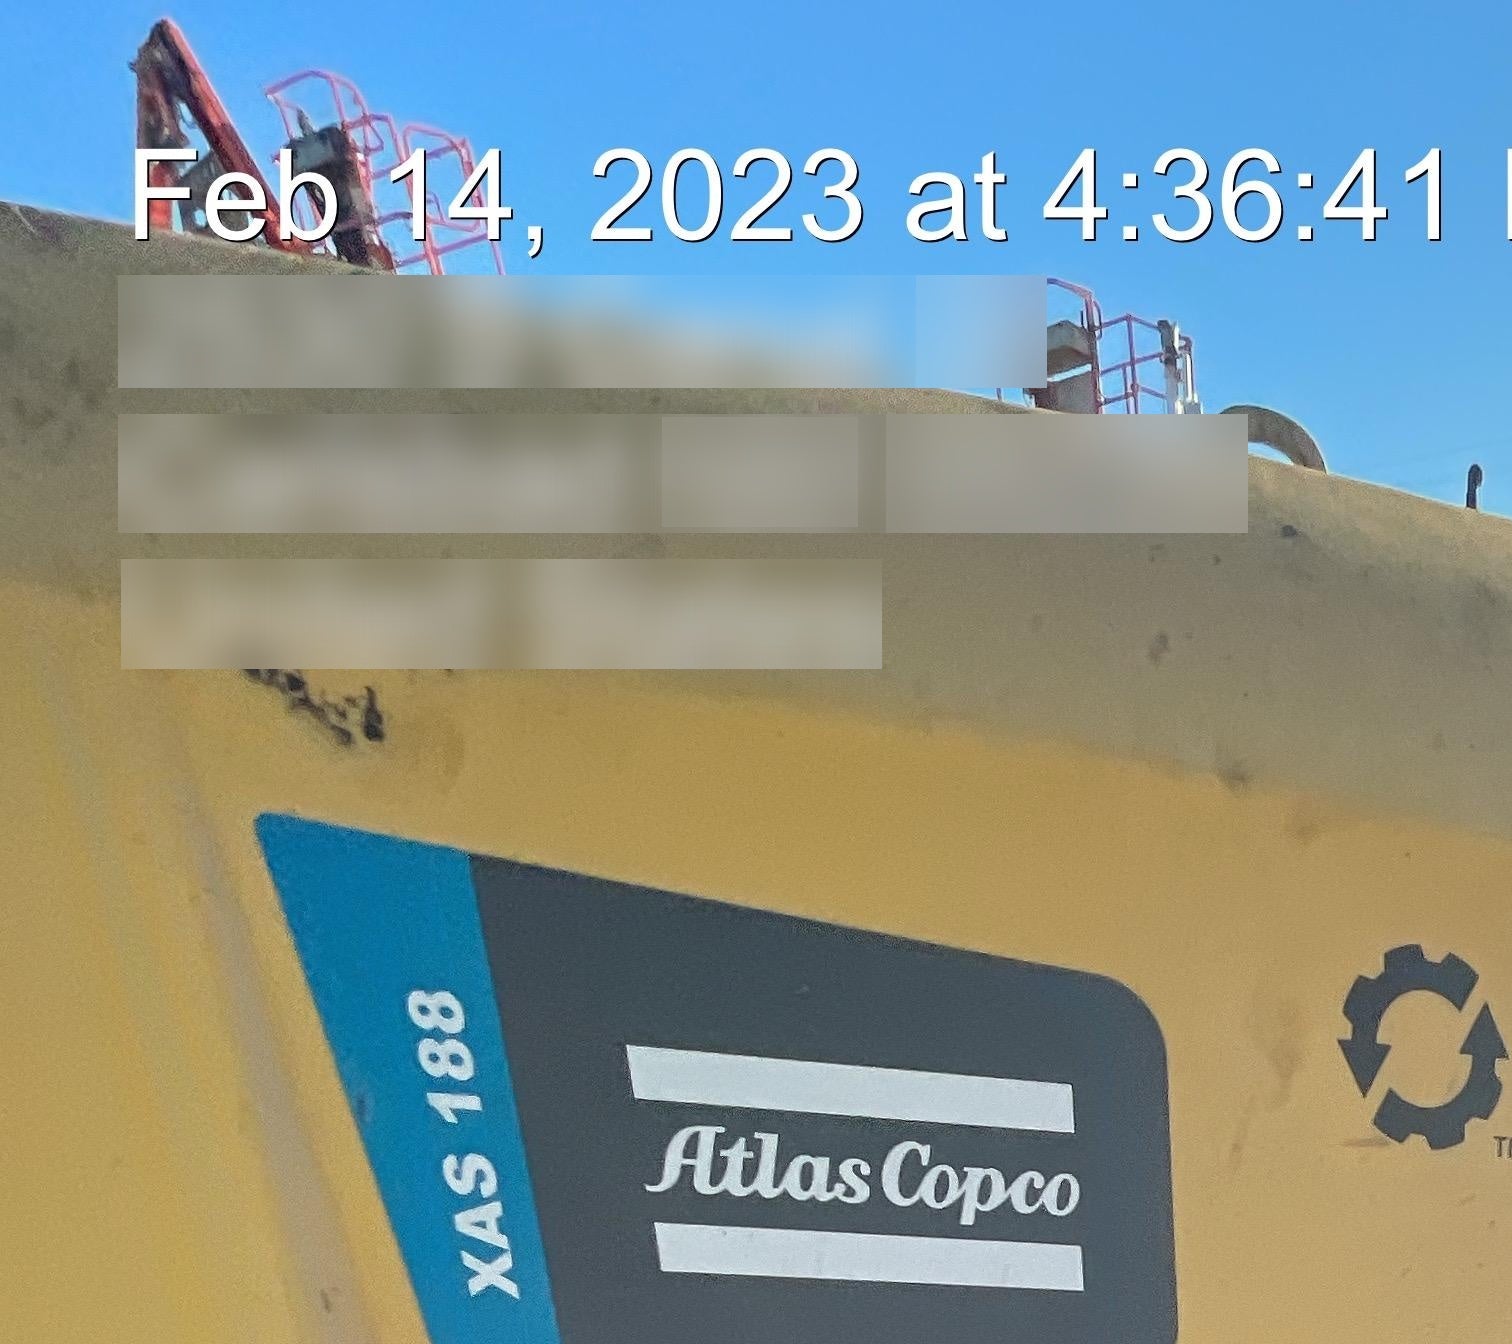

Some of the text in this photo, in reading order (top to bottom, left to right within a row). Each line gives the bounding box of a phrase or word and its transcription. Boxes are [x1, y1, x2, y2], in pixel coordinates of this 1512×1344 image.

[405, 988, 522, 1300] XAS 188
[644, 1124, 1082, 1226] Atlas Copco
